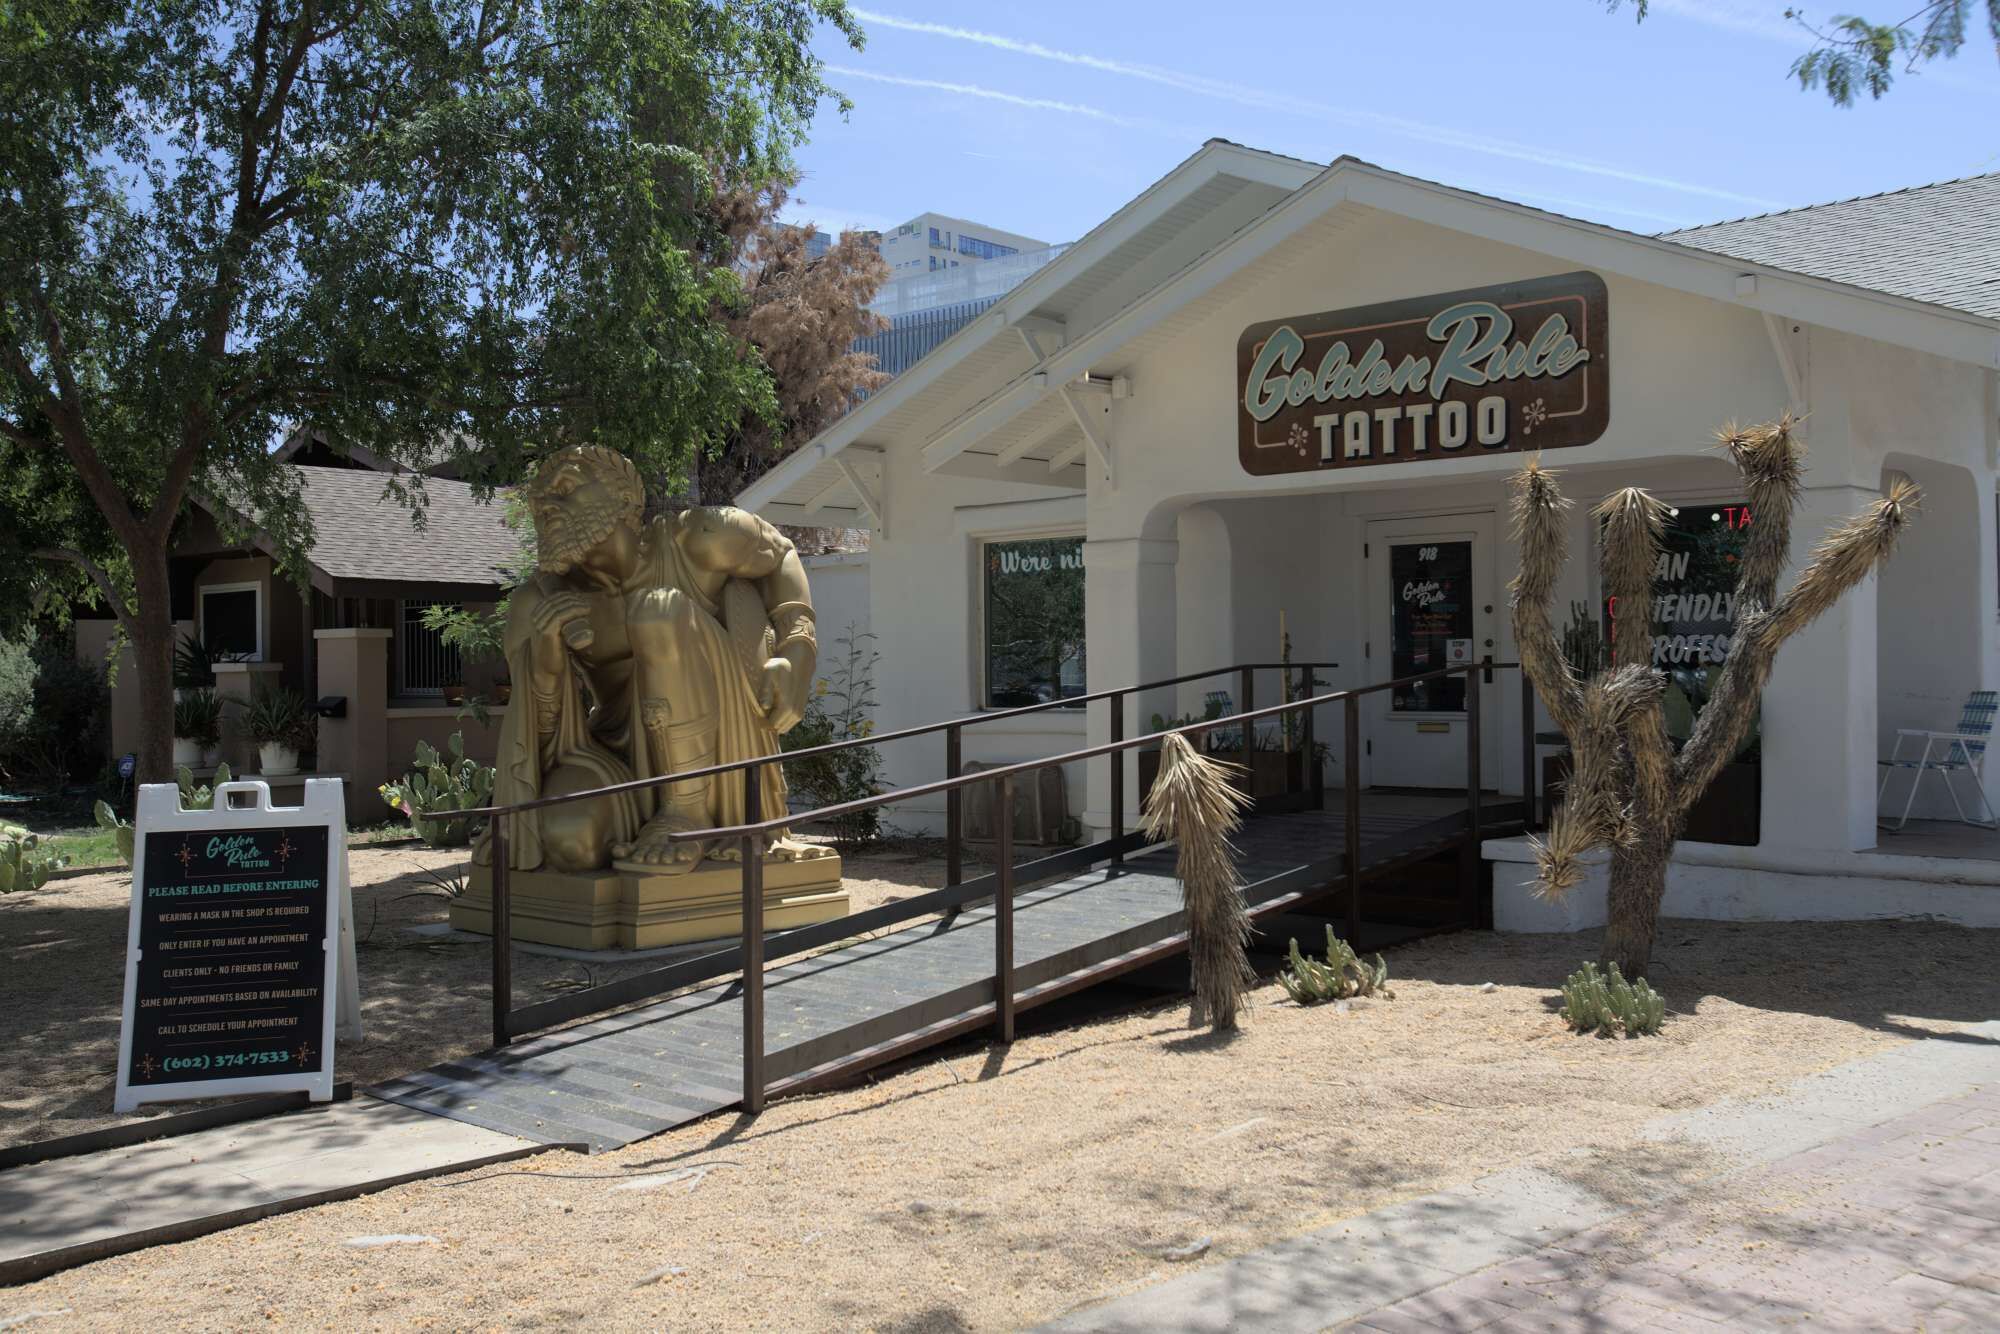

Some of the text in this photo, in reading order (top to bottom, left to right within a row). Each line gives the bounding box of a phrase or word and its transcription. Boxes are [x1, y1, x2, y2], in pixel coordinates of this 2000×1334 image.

[1245, 301, 1590, 421] Golden Rule
[1313, 396, 1506, 460] TATTOO
[1419, 546, 1438, 561] 918
[1402, 580, 1440, 601] Golden
[1417, 590, 1446, 608] Rule
[1649, 634, 1733, 664] ROFES
[206, 835, 255, 859] Golden
[224, 846, 262, 867] Rule
[240, 859, 270, 868] TATTOO
[149, 879, 319, 897] PLEASE READ BEFORE ENTERING
[159, 905, 309, 922] WEARING A MASK IN THE SHOP IS REQUIRED
[159, 933, 309, 951] ONLY ENTER IF YOU HAVE AN APPOINTMENT
[163, 968, 193, 978] CLIENTS
[194, 967, 212, 976] ONLY
[219, 966, 230, 974] NO
[231, 963, 261, 973] FRIENDS
[263, 963, 273, 972] OR
[274, 961, 299, 971] FAMILY
[140, 988, 318, 1008] SAME DAY APPOINTMENTS BASED ON AVAILABILITY
[158, 1017, 299, 1035] CALL TO SCHEDULE YOUR APPOINTMENT
[163, 1050, 289, 1072] (602) 374-7533
